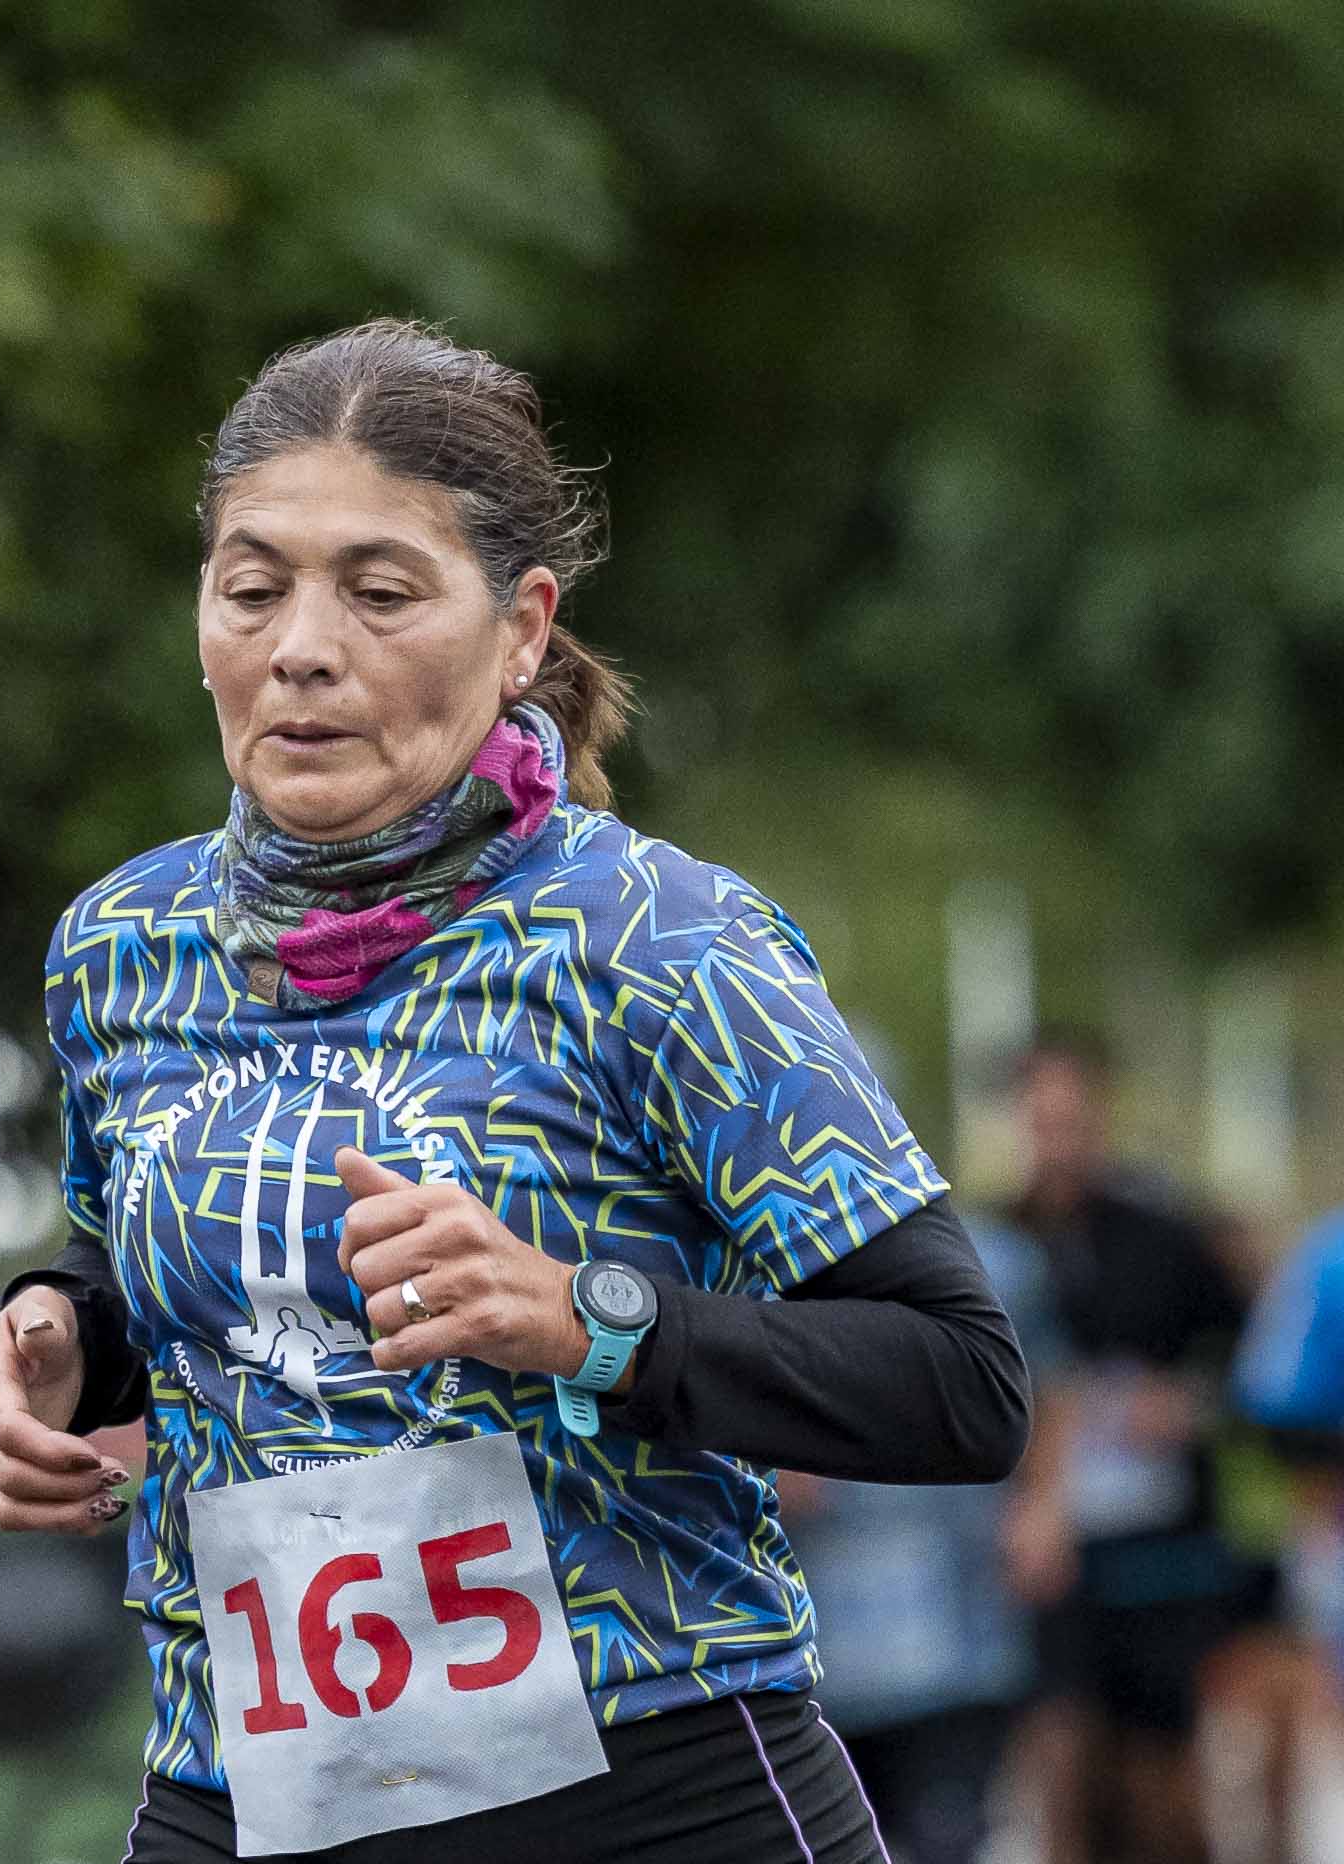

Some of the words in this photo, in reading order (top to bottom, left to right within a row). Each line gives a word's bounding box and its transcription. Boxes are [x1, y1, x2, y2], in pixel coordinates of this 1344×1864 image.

[274, 1043, 301, 1077] X
[310, 1044, 346, 1085] EL
[350, 1064, 460, 1186] AUTISM
[223, 1521, 542, 1735] 165
